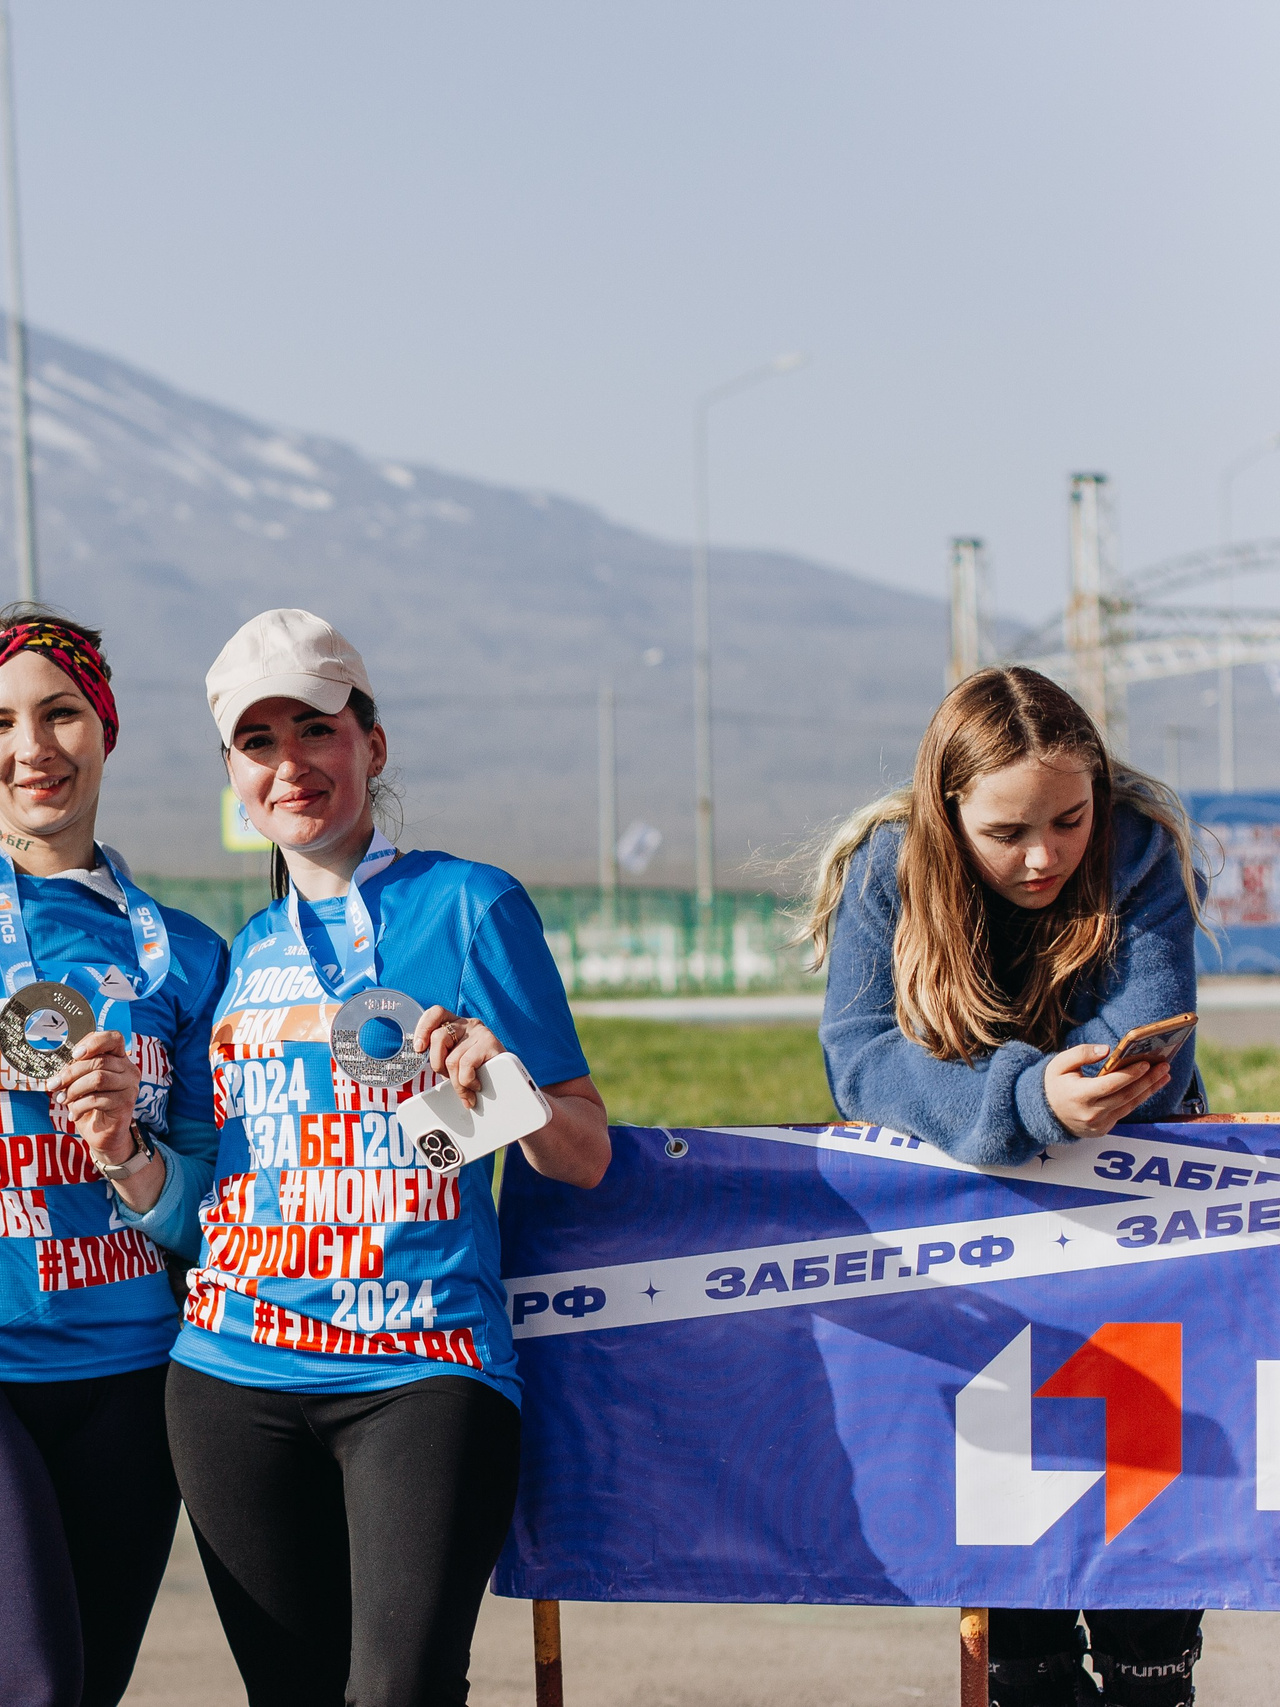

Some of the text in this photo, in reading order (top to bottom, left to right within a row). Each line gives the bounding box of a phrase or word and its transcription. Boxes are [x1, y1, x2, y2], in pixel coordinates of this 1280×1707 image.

[6, 834, 34, 851] БЕГ
[137, 907, 157, 938] ПСБ
[350, 901, 366, 936] ПСБ
[225, 1058, 310, 1119] 2024
[242, 1113, 427, 1168] #ЗАБЕГ20
[279, 1169, 460, 1223] #МОМЕНТ
[1116, 1198, 1280, 1248] ЗАБЕ
[202, 1224, 385, 1280] ГОРДОСТЬ
[705, 1235, 1014, 1300] ЗАБЕГ.РФ
[331, 1279, 437, 1331] 2024
